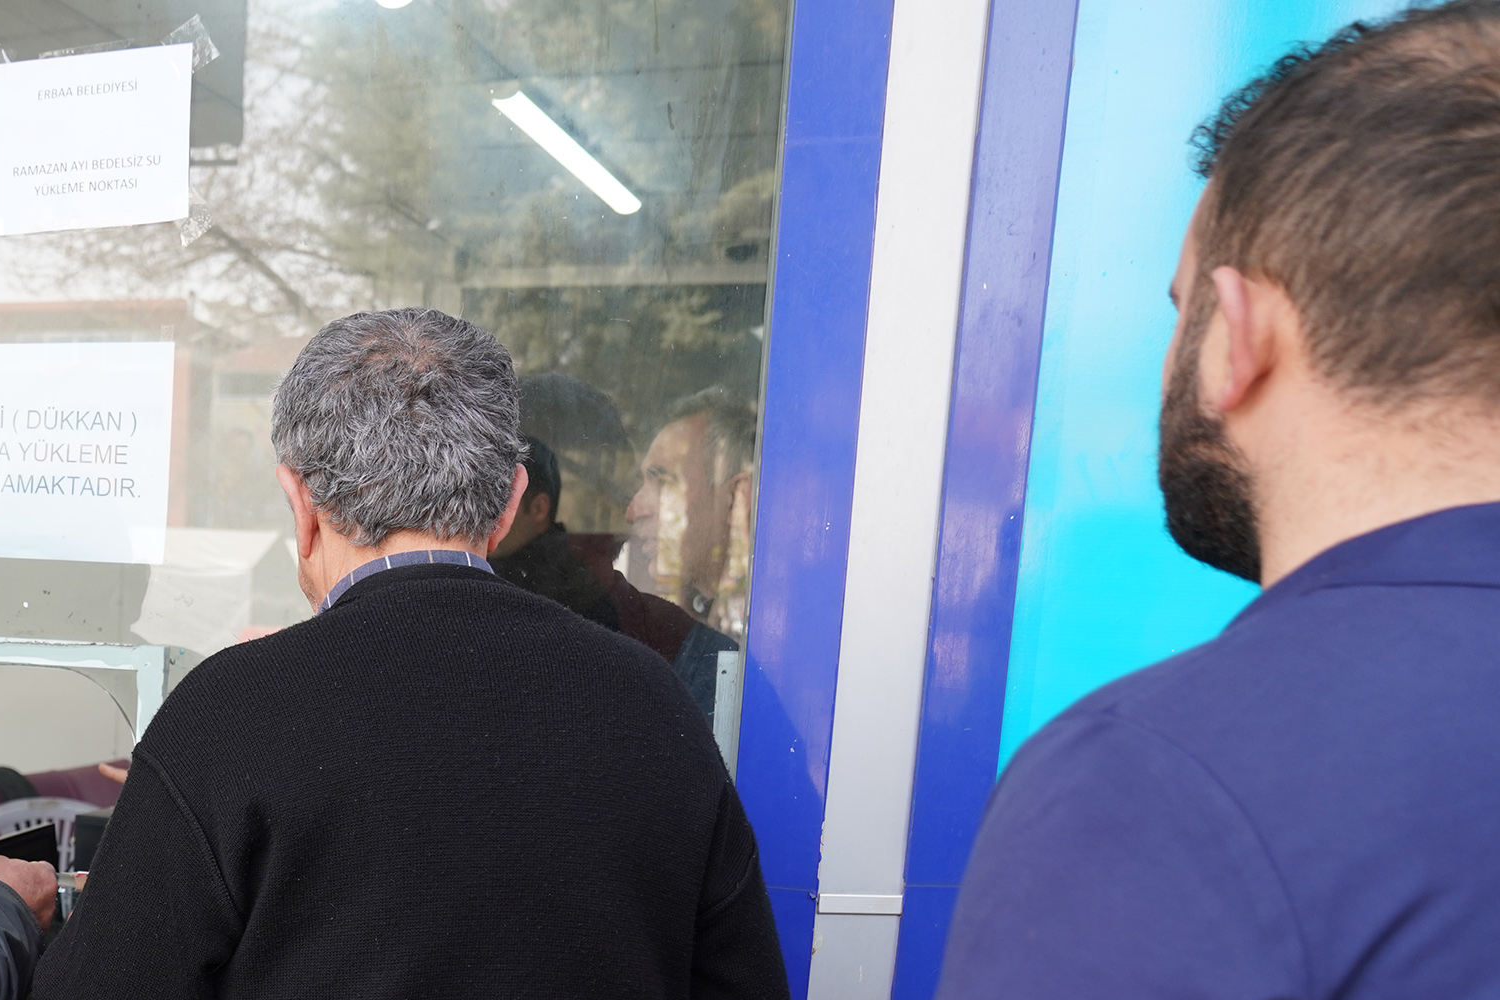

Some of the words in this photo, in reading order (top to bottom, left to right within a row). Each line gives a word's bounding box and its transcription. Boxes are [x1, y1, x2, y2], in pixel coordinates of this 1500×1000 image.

[37, 86, 73, 101] ERBAA
[76, 78, 138, 97] BELEDİYESİ
[12, 162, 68, 177] RAMAZAN
[70, 160, 88, 172] AYI
[91, 154, 143, 170] BEDELSİZ
[146, 155, 161, 166] SU
[34, 181, 85, 196] YÜKLEME
[88, 178, 138, 192] NOKTASI
[26, 406, 122, 431] DÜKKAN
[18, 439, 128, 465] YÜKLEME
